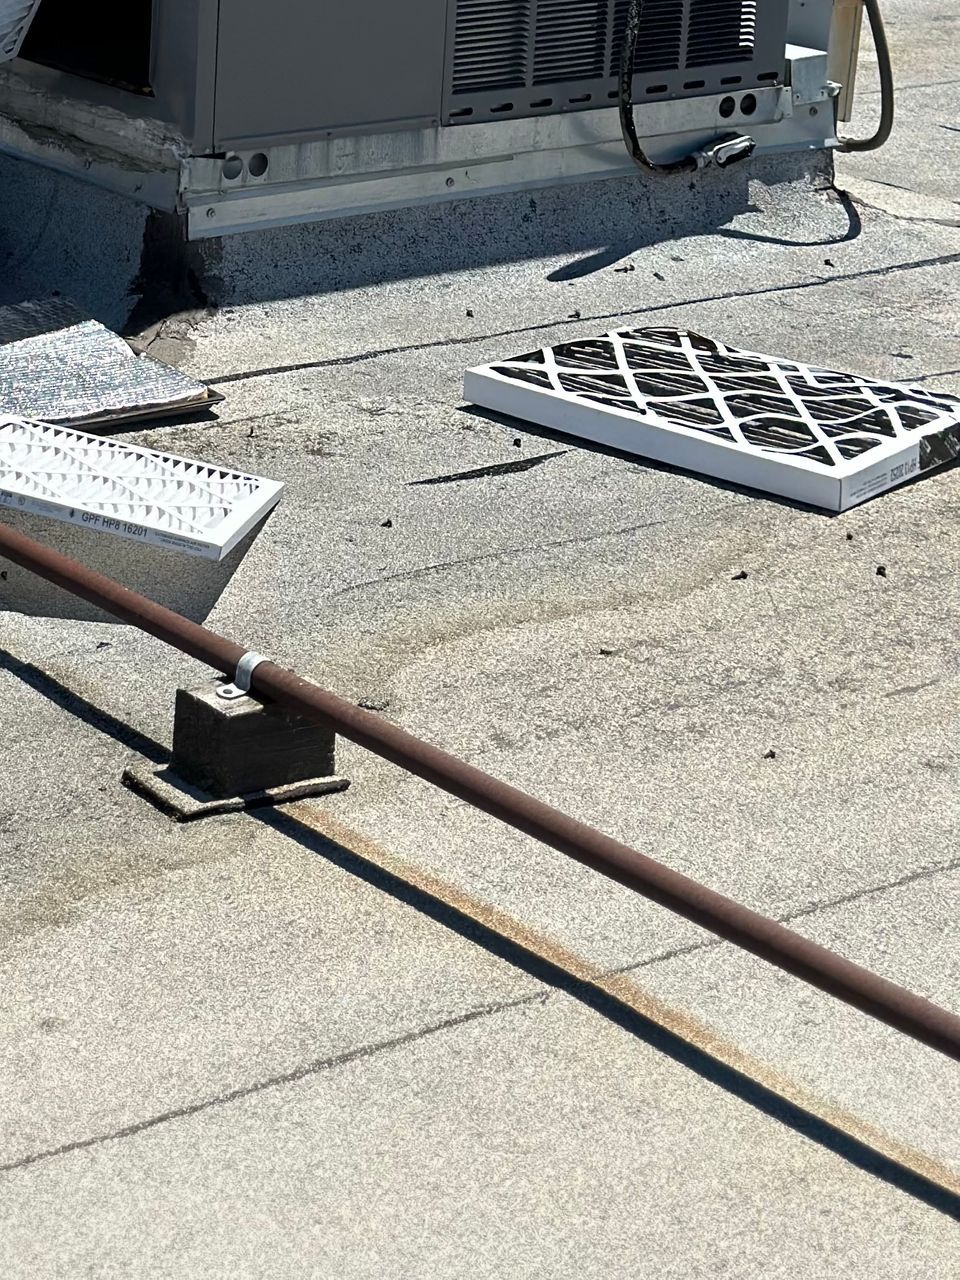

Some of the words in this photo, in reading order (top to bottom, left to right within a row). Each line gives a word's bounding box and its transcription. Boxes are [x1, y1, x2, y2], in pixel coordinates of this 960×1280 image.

[81, 511, 100, 525] GPF
[102, 517, 121, 530] HP8
[123, 523, 148, 538] 16201
